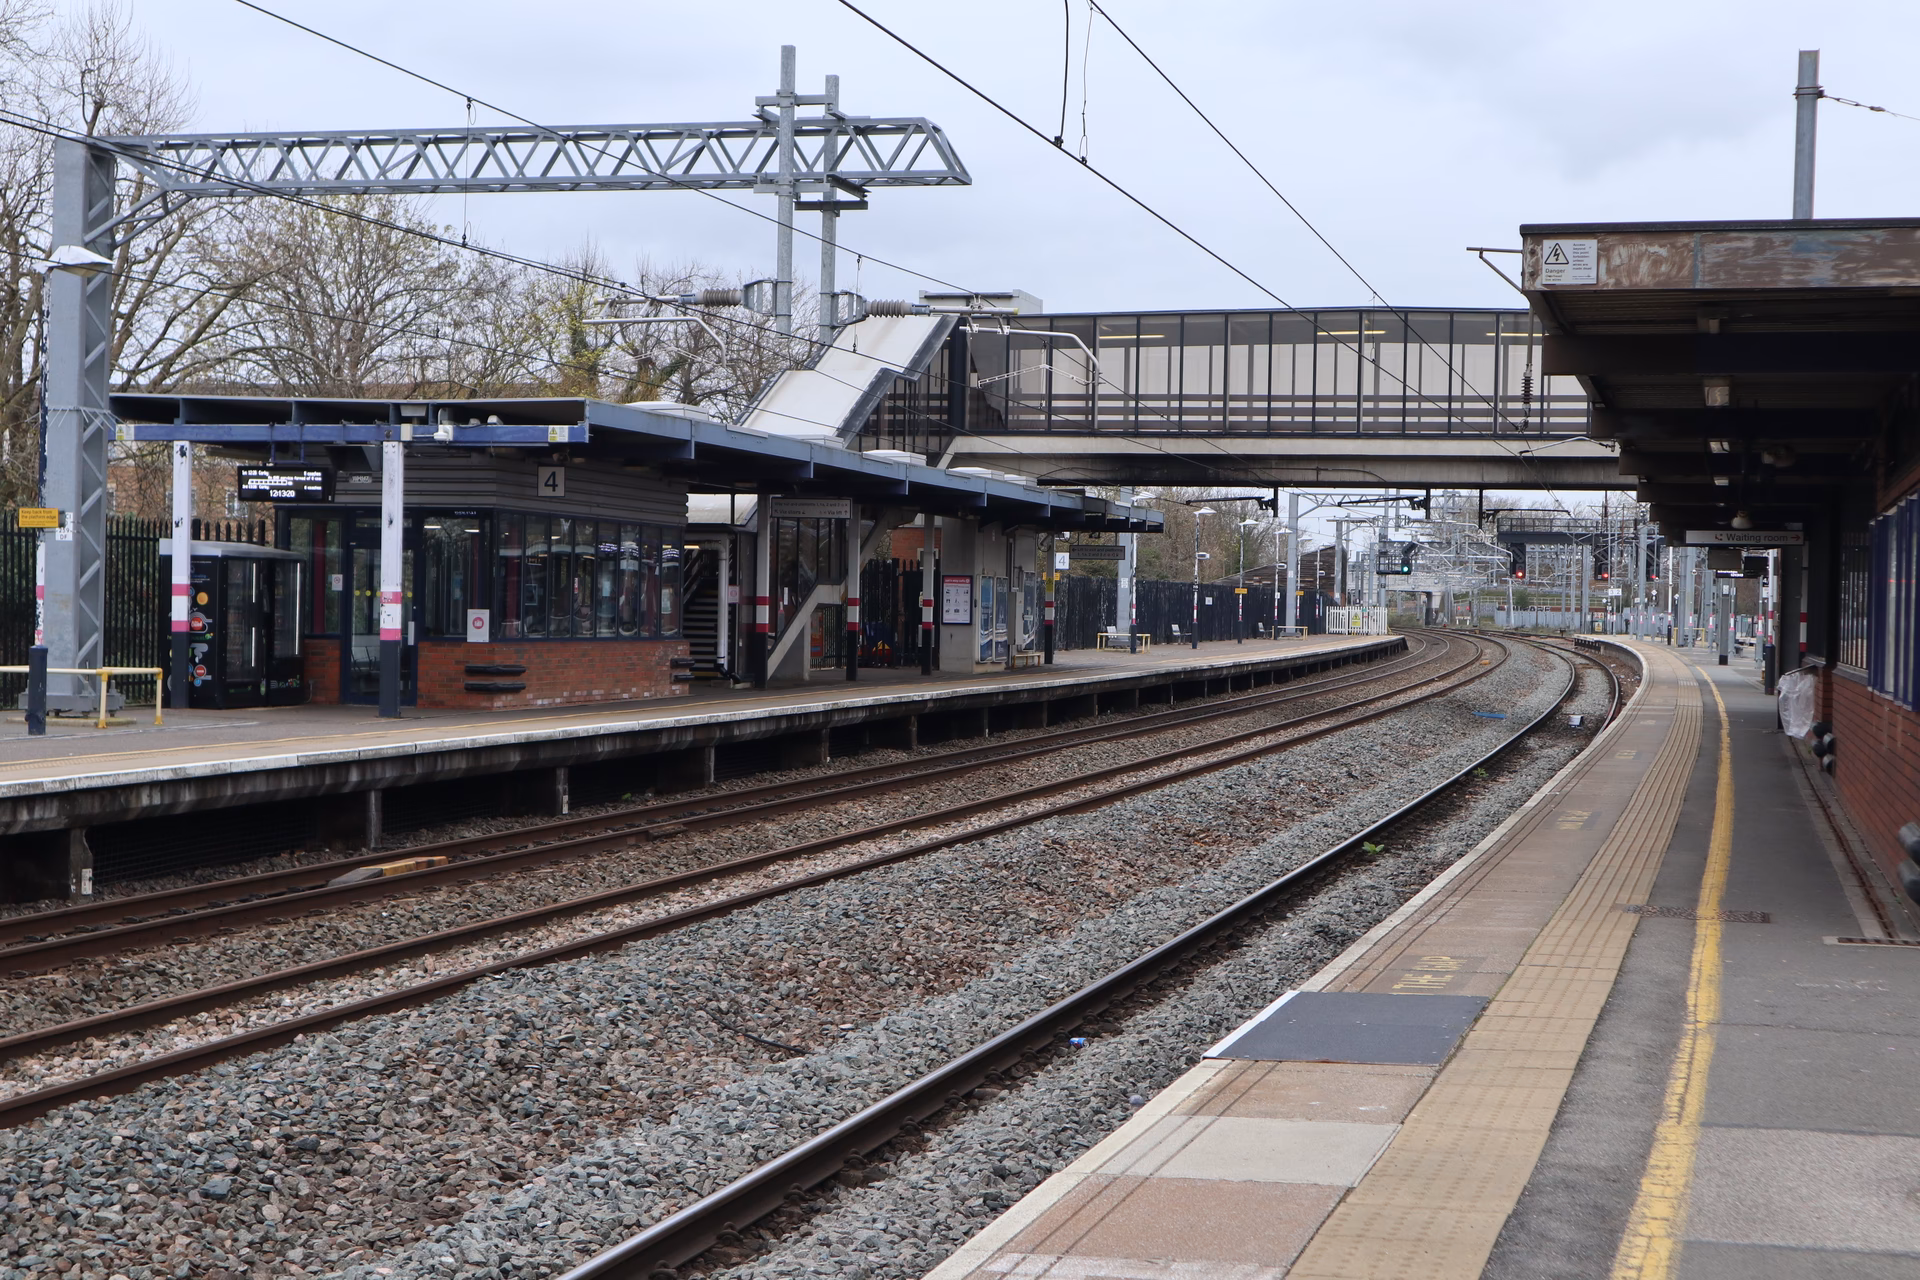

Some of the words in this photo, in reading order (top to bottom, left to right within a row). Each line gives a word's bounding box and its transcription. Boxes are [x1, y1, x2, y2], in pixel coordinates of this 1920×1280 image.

[544, 471, 558, 492] 4
[1726, 534, 1761, 543] Waiting
[1059, 556, 1066, 566] 4
[1411, 956, 1468, 971] GAP
[1392, 974, 1454, 989] THE
